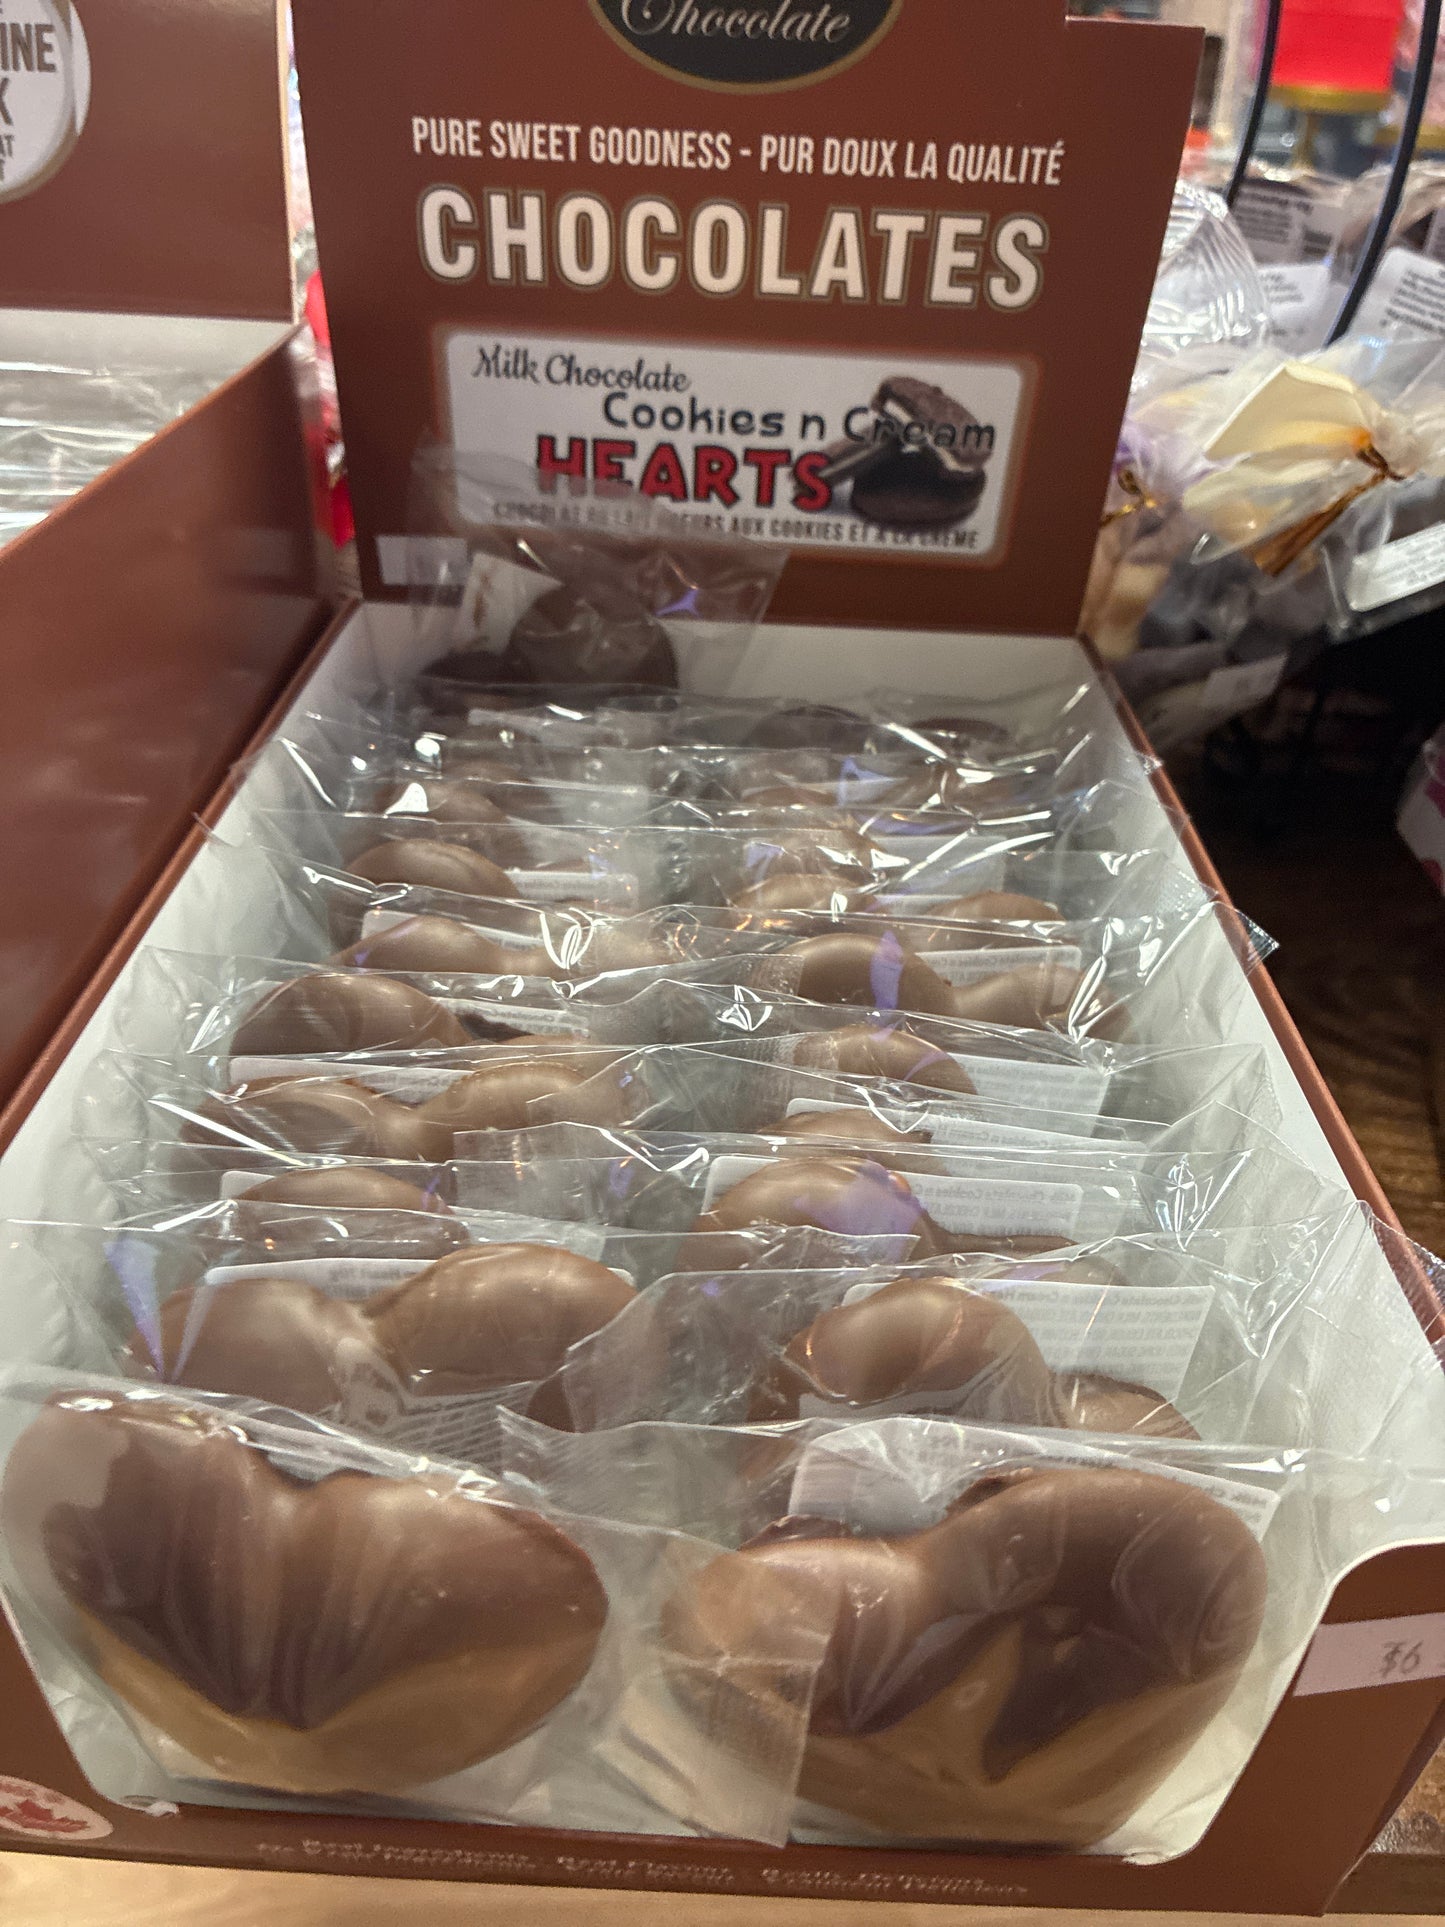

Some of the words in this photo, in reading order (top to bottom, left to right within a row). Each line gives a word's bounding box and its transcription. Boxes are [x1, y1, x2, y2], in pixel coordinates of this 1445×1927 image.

[620, 0, 851, 43] Chocolate
[411, 115, 483, 158] PURE
[489, 119, 582, 162] SWEET
[588, 124, 733, 171] GOODNESS
[759, 133, 815, 175] PUR
[821, 136, 898, 179] DOUX
[903, 140, 939, 180] LA
[946, 139, 1066, 185] QUALITÉ
[419, 185, 1048, 309] CHOCOLATES
[471, 342, 541, 384] Milk
[545, 353, 691, 393] Chocolate
[602, 391, 785, 438] Cookies
[801, 413, 827, 440] n
[843, 406, 996, 451] Cream
[536, 434, 833, 512] HEARTS
[769, 518, 843, 540] COOKIES
